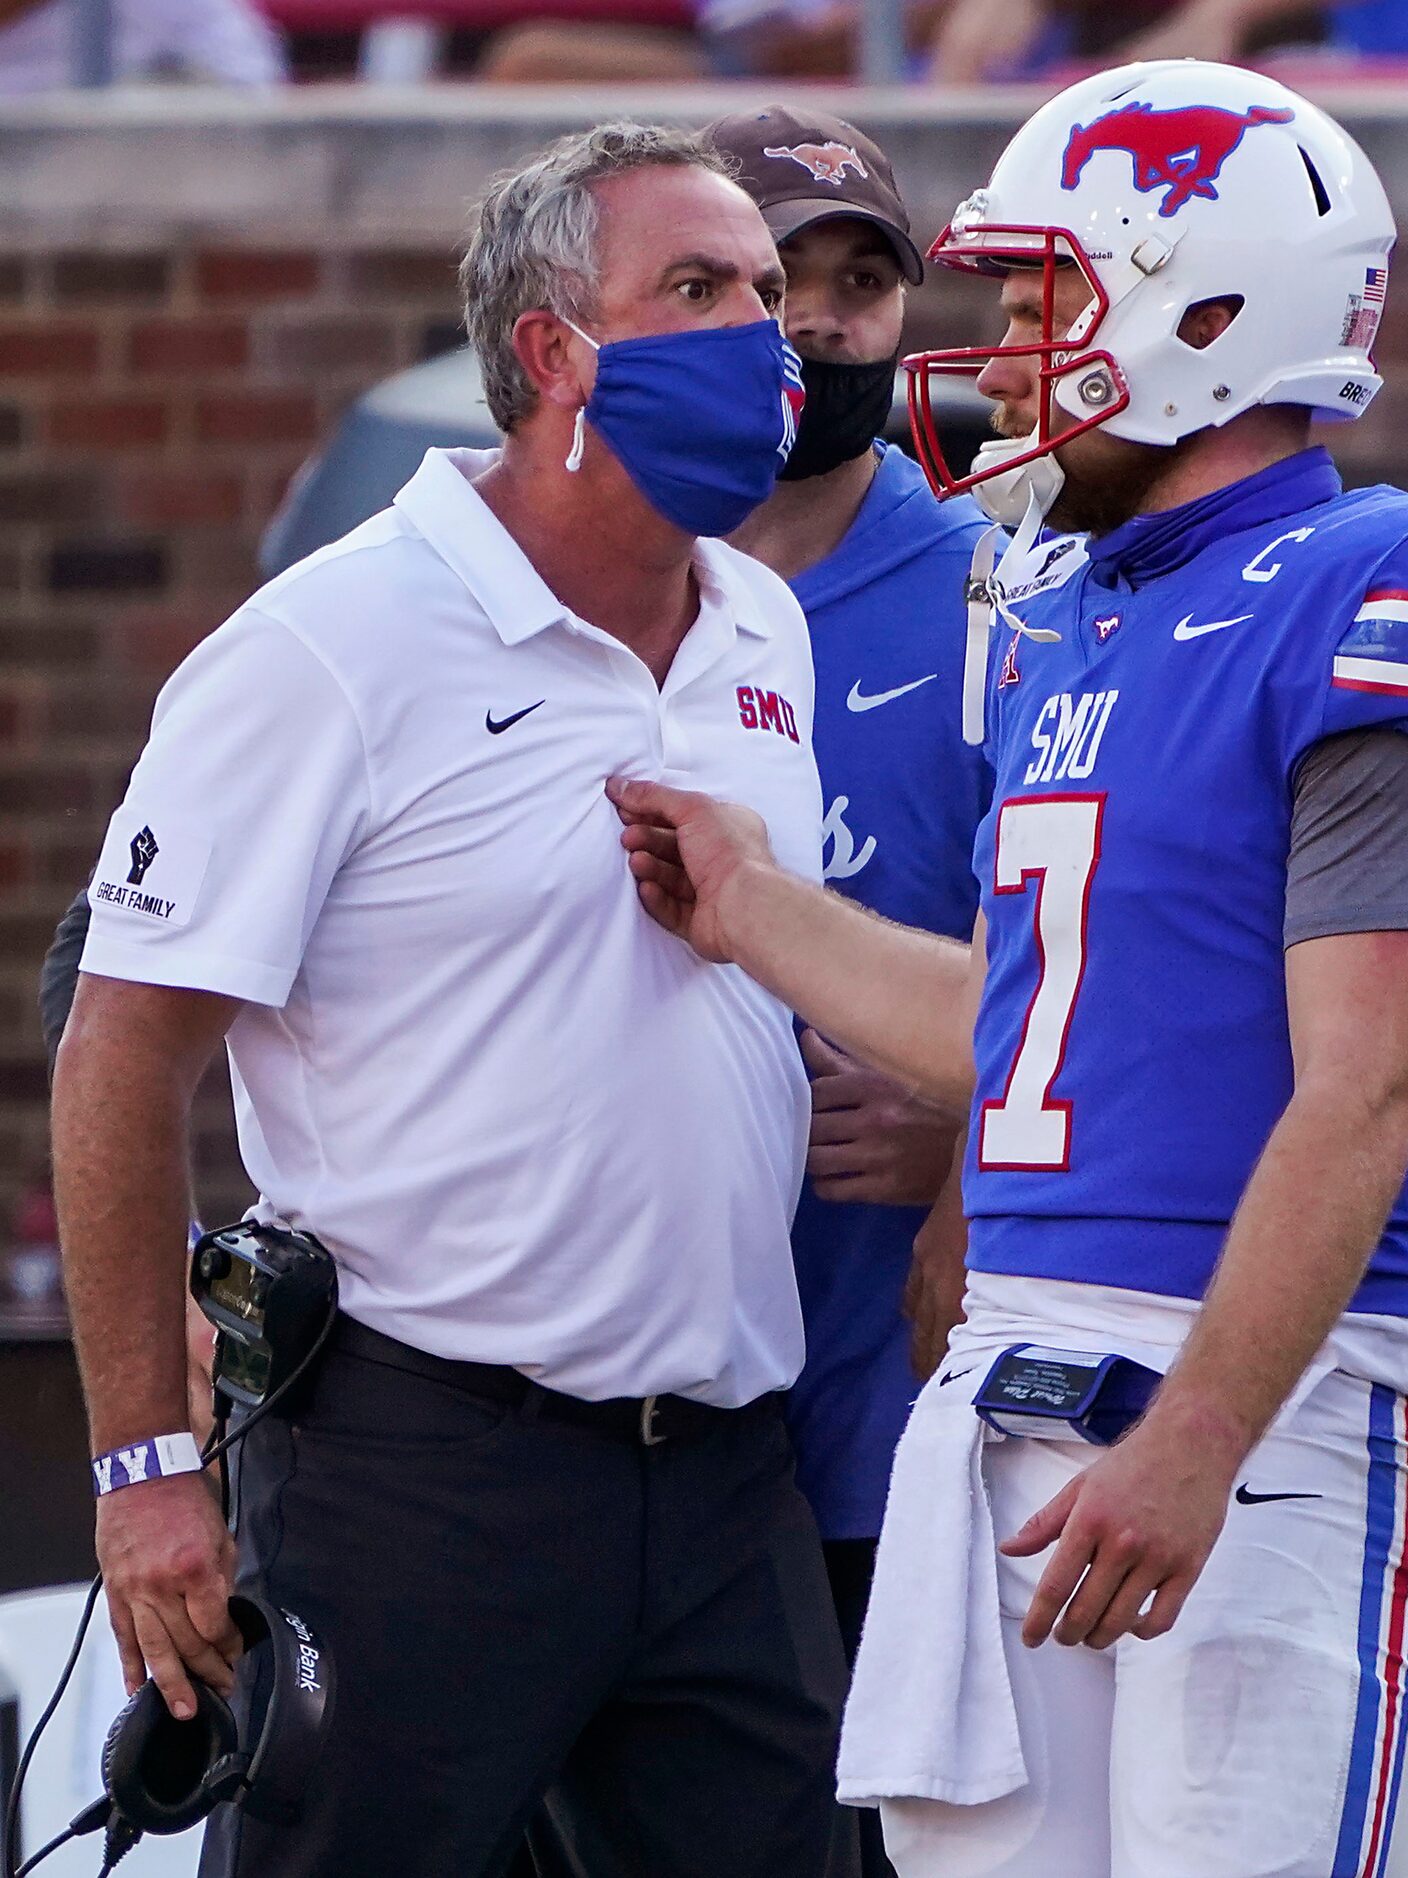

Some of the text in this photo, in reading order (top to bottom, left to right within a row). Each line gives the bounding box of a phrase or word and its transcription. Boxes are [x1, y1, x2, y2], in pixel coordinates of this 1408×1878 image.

[1242, 528, 1316, 583] C
[735, 685, 801, 746] SMU
[1023, 689, 1120, 785] SMU
[96, 881, 176, 918] GREAT FAMILY
[978, 791, 1108, 1172] 7
[300, 1643, 321, 1693] Bank
